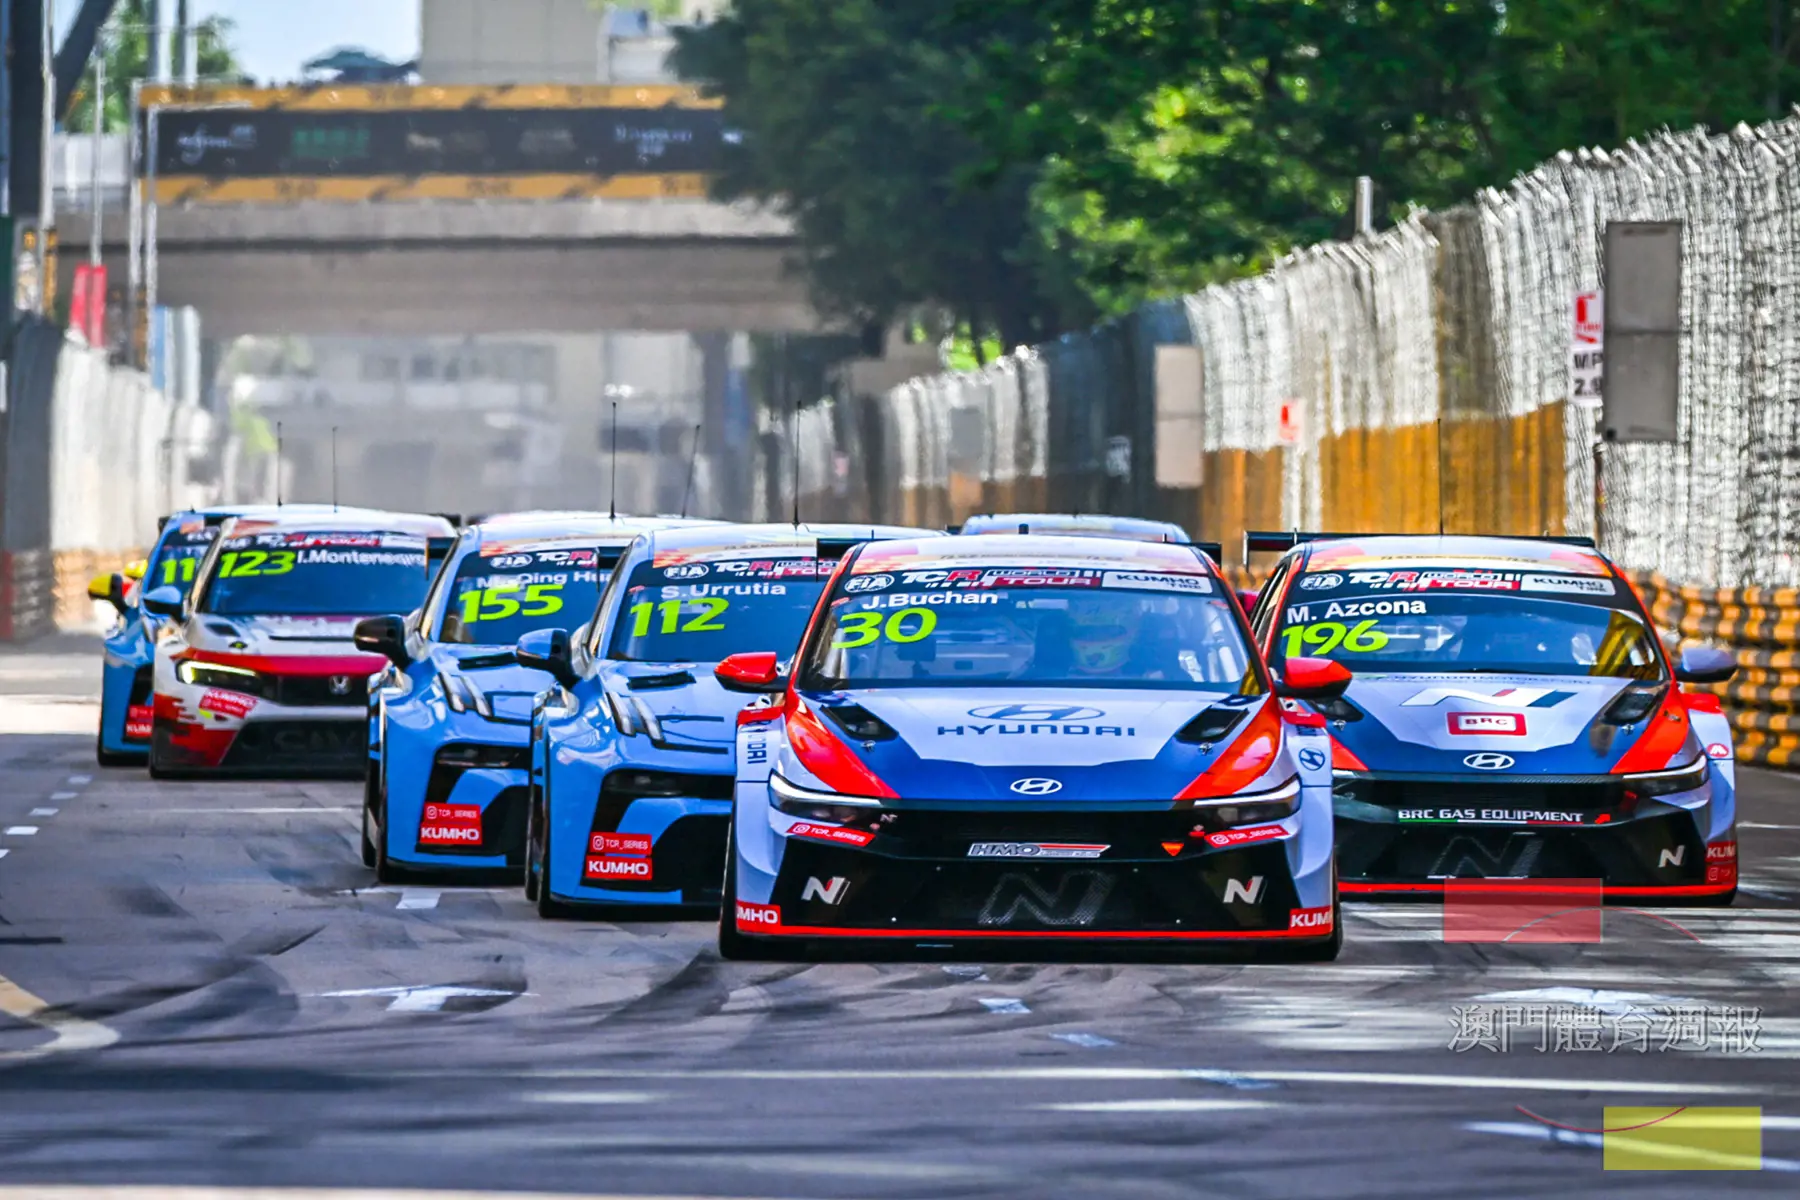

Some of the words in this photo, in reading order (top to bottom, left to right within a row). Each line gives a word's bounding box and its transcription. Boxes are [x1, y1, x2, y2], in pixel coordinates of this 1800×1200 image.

[492, 555, 530, 567] FIA
[536, 551, 593, 561] TCR
[219, 551, 296, 578] 123
[665, 565, 706, 578] FIA
[713, 561, 774, 573] TCR
[902, 570, 982, 583] TCR
[1003, 577, 1092, 586] TOUR
[1117, 573, 1200, 585] KUMHO
[1302, 575, 1340, 590] FIA
[1349, 571, 1419, 583] TCR
[1533, 577, 1605, 588] KUMHO
[661, 583, 786, 598] S.Urrutia
[848, 577, 889, 592] FIA
[1437, 580, 1513, 589] TOUR
[459, 584, 563, 623] 155
[862, 591, 998, 609] J.Buchan
[630, 598, 729, 637] 112
[1287, 606, 1317, 624] M.
[1324, 600, 1427, 619] Azcona
[831, 607, 937, 649] 30
[1282, 619, 1389, 659] 196
[1465, 717, 1509, 726] BRC
[937, 724, 1136, 736] HYUNDAI
[1398, 809, 1434, 819] BRC
[1439, 808, 1476, 819] GAS
[1481, 809, 1584, 822] EQUIPMENT
[421, 826, 479, 840] KUMHO
[970, 843, 1041, 856] HMO
[589, 861, 649, 875] KUMHO
[737, 906, 778, 924] MHO
[1290, 911, 1332, 928] KUM
